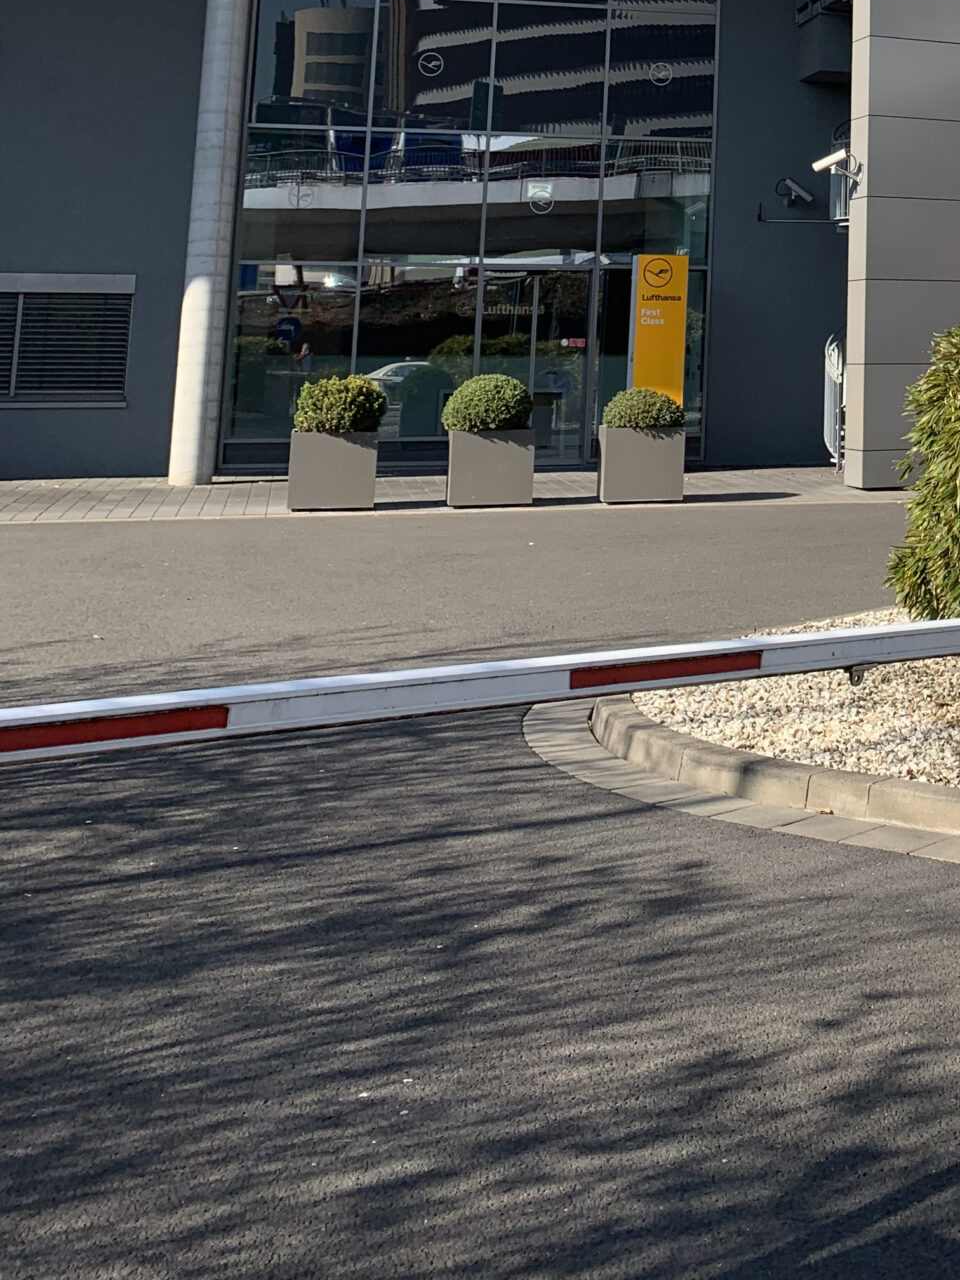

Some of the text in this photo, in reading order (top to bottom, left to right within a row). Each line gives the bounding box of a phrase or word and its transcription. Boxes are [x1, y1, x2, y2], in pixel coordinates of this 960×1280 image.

[641, 293, 682, 302] Lufthansa
[640, 308, 660, 316] First
[640, 317, 665, 325] Class
